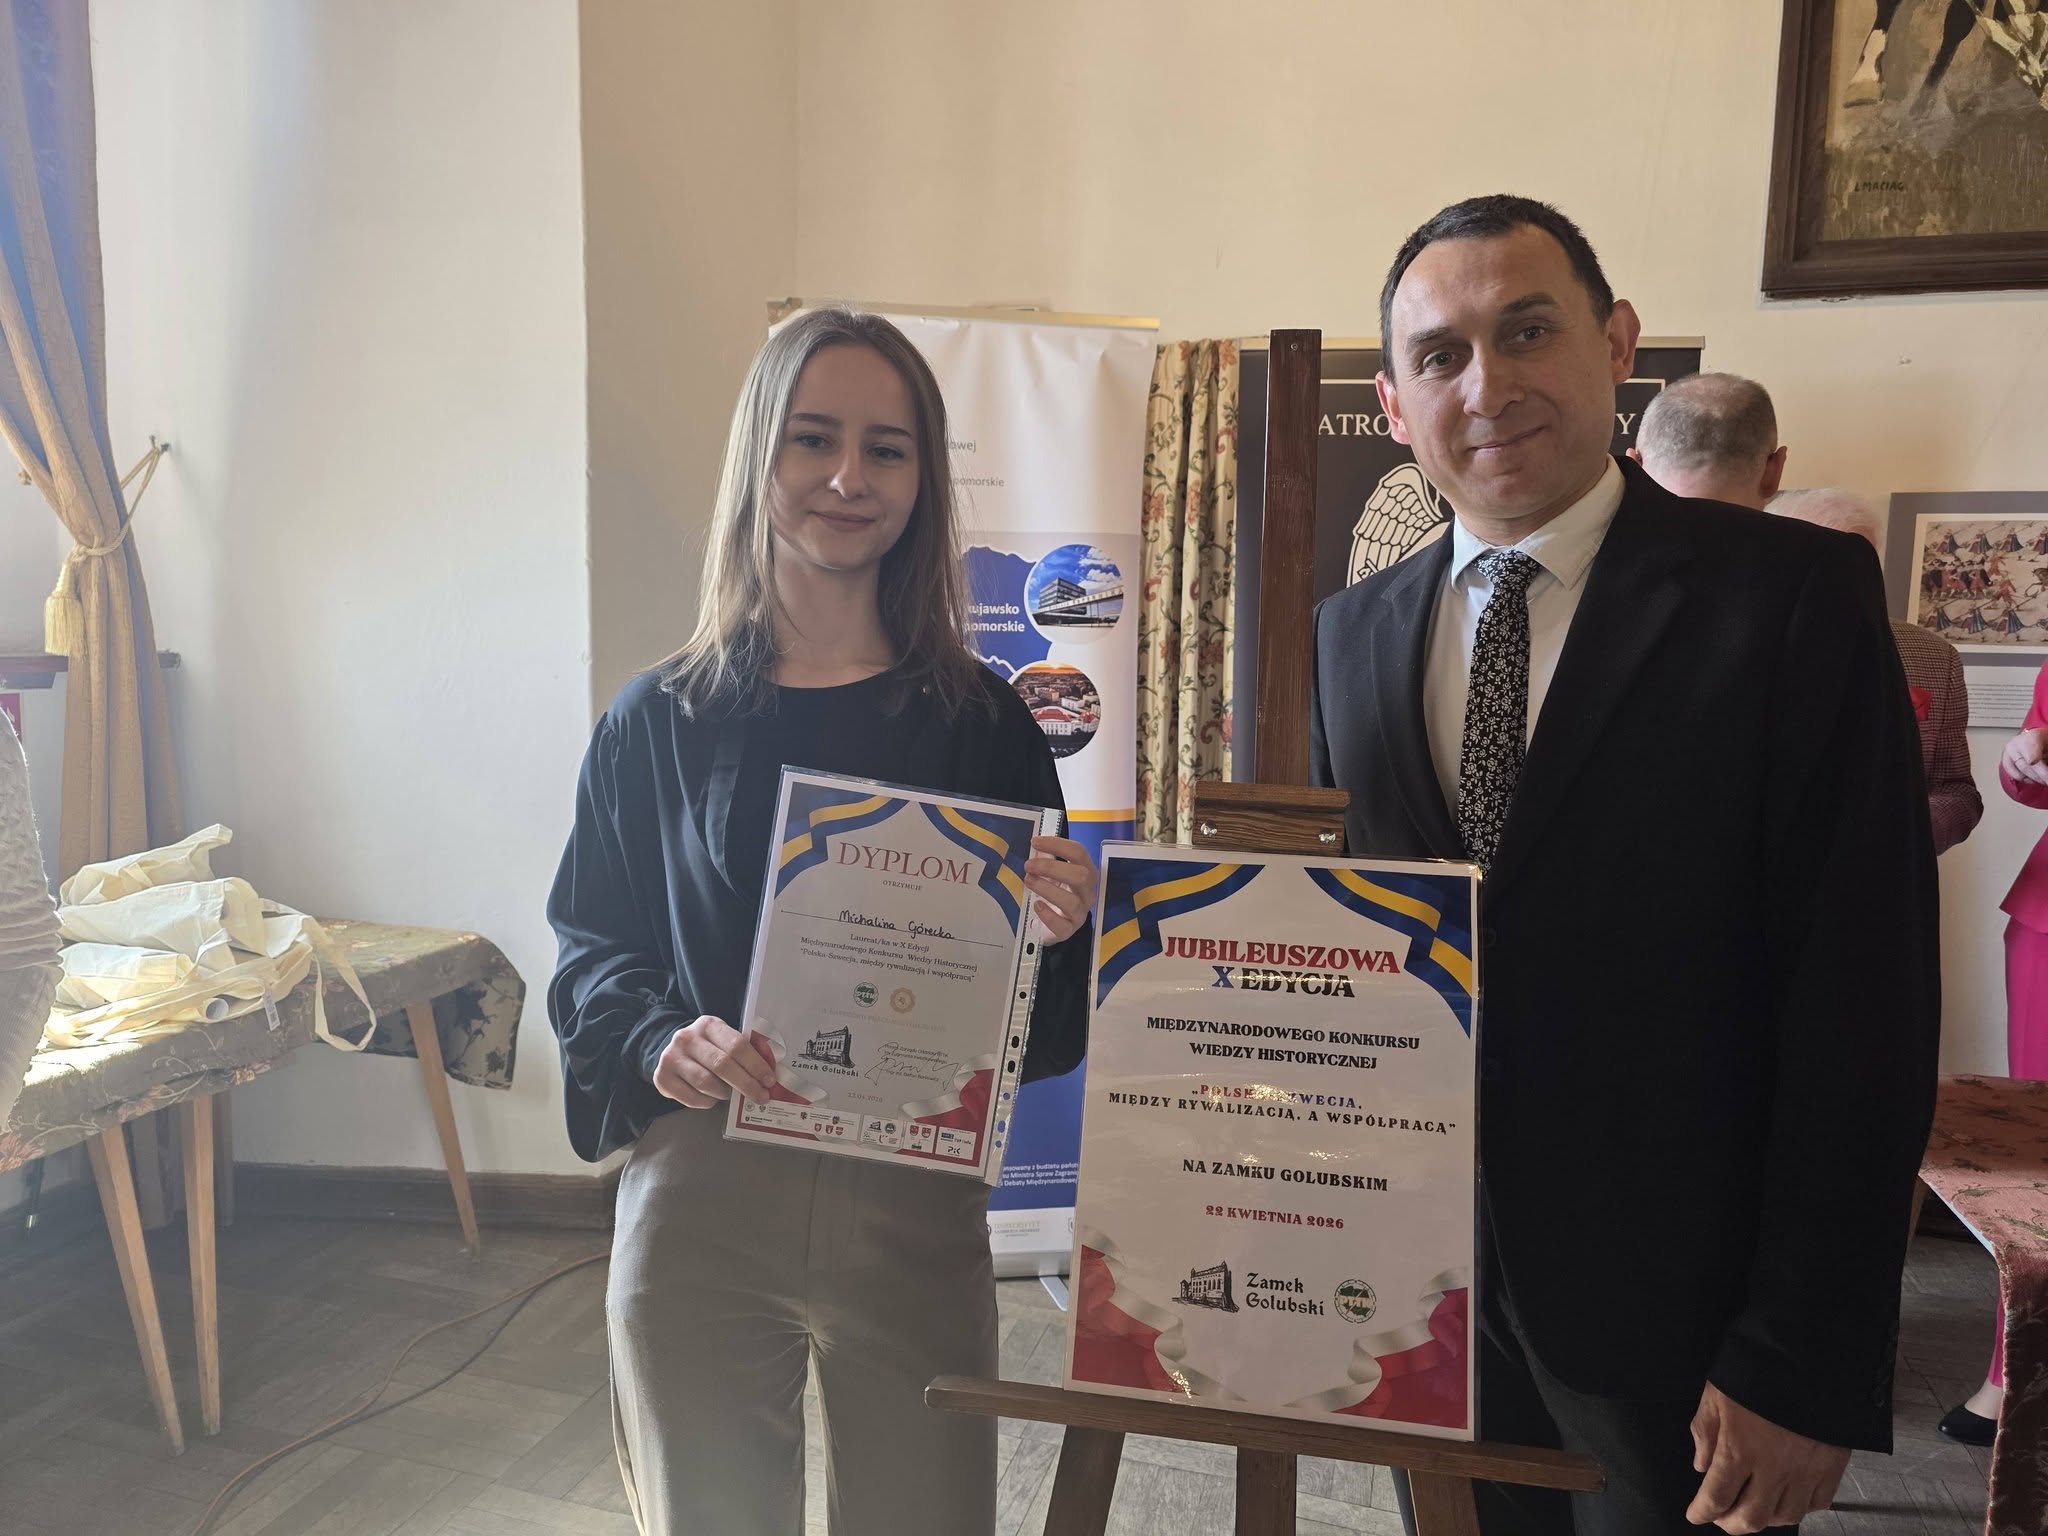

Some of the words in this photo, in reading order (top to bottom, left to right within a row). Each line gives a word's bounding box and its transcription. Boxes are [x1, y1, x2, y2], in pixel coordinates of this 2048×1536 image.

[1318, 413, 1392, 435] ATRO
[836, 842, 972, 885] DYPLOM
[839, 910, 897, 930] Michalina
[908, 920, 955, 939] Górecka
[800, 937, 867, 954] Międzynarodowego
[868, 947, 904, 959] Konkursu
[907, 953, 932, 965] Wiedzy
[934, 958, 978, 972] Historycznej
[850, 934, 890, 946] Laureat/ka
[900, 941, 906, 949] X
[907, 943, 930, 953] Edycji
[1165, 937, 1400, 974] JUBILEUSZOWA
[860, 958, 885, 969] między
[886, 962, 926, 975] rywalizacją
[1211, 966, 1235, 988] X
[1240, 967, 1355, 998] EDYCJA
[1147, 1016, 1325, 1042] MIĘDZYNARODOWEGO
[1328, 1031, 1420, 1050] KONKURSU
[791, 1060, 819, 1071] Zamek
[822, 1065, 859, 1077] Golubski
[1189, 1042, 1254, 1059] WIEDZY
[1257, 1047, 1377, 1069] HISTORYCZNEJ
[1109, 1092, 1171, 1107] MIĘDZY
[1308, 1111, 1319, 1122] A
[1183, 1159, 1207, 1173] NA
[1212, 1162, 1275, 1180] ZAMKU
[1280, 1169, 1388, 1191] GOLUBSKIM
[1205, 1205, 1224, 1217] 22
[1227, 1207, 1303, 1225] KWIETNIA
[1306, 1215, 1344, 1229] 2026
[1246, 1272, 1304, 1293] Zamek
[1246, 1292, 1324, 1316] Golubski
